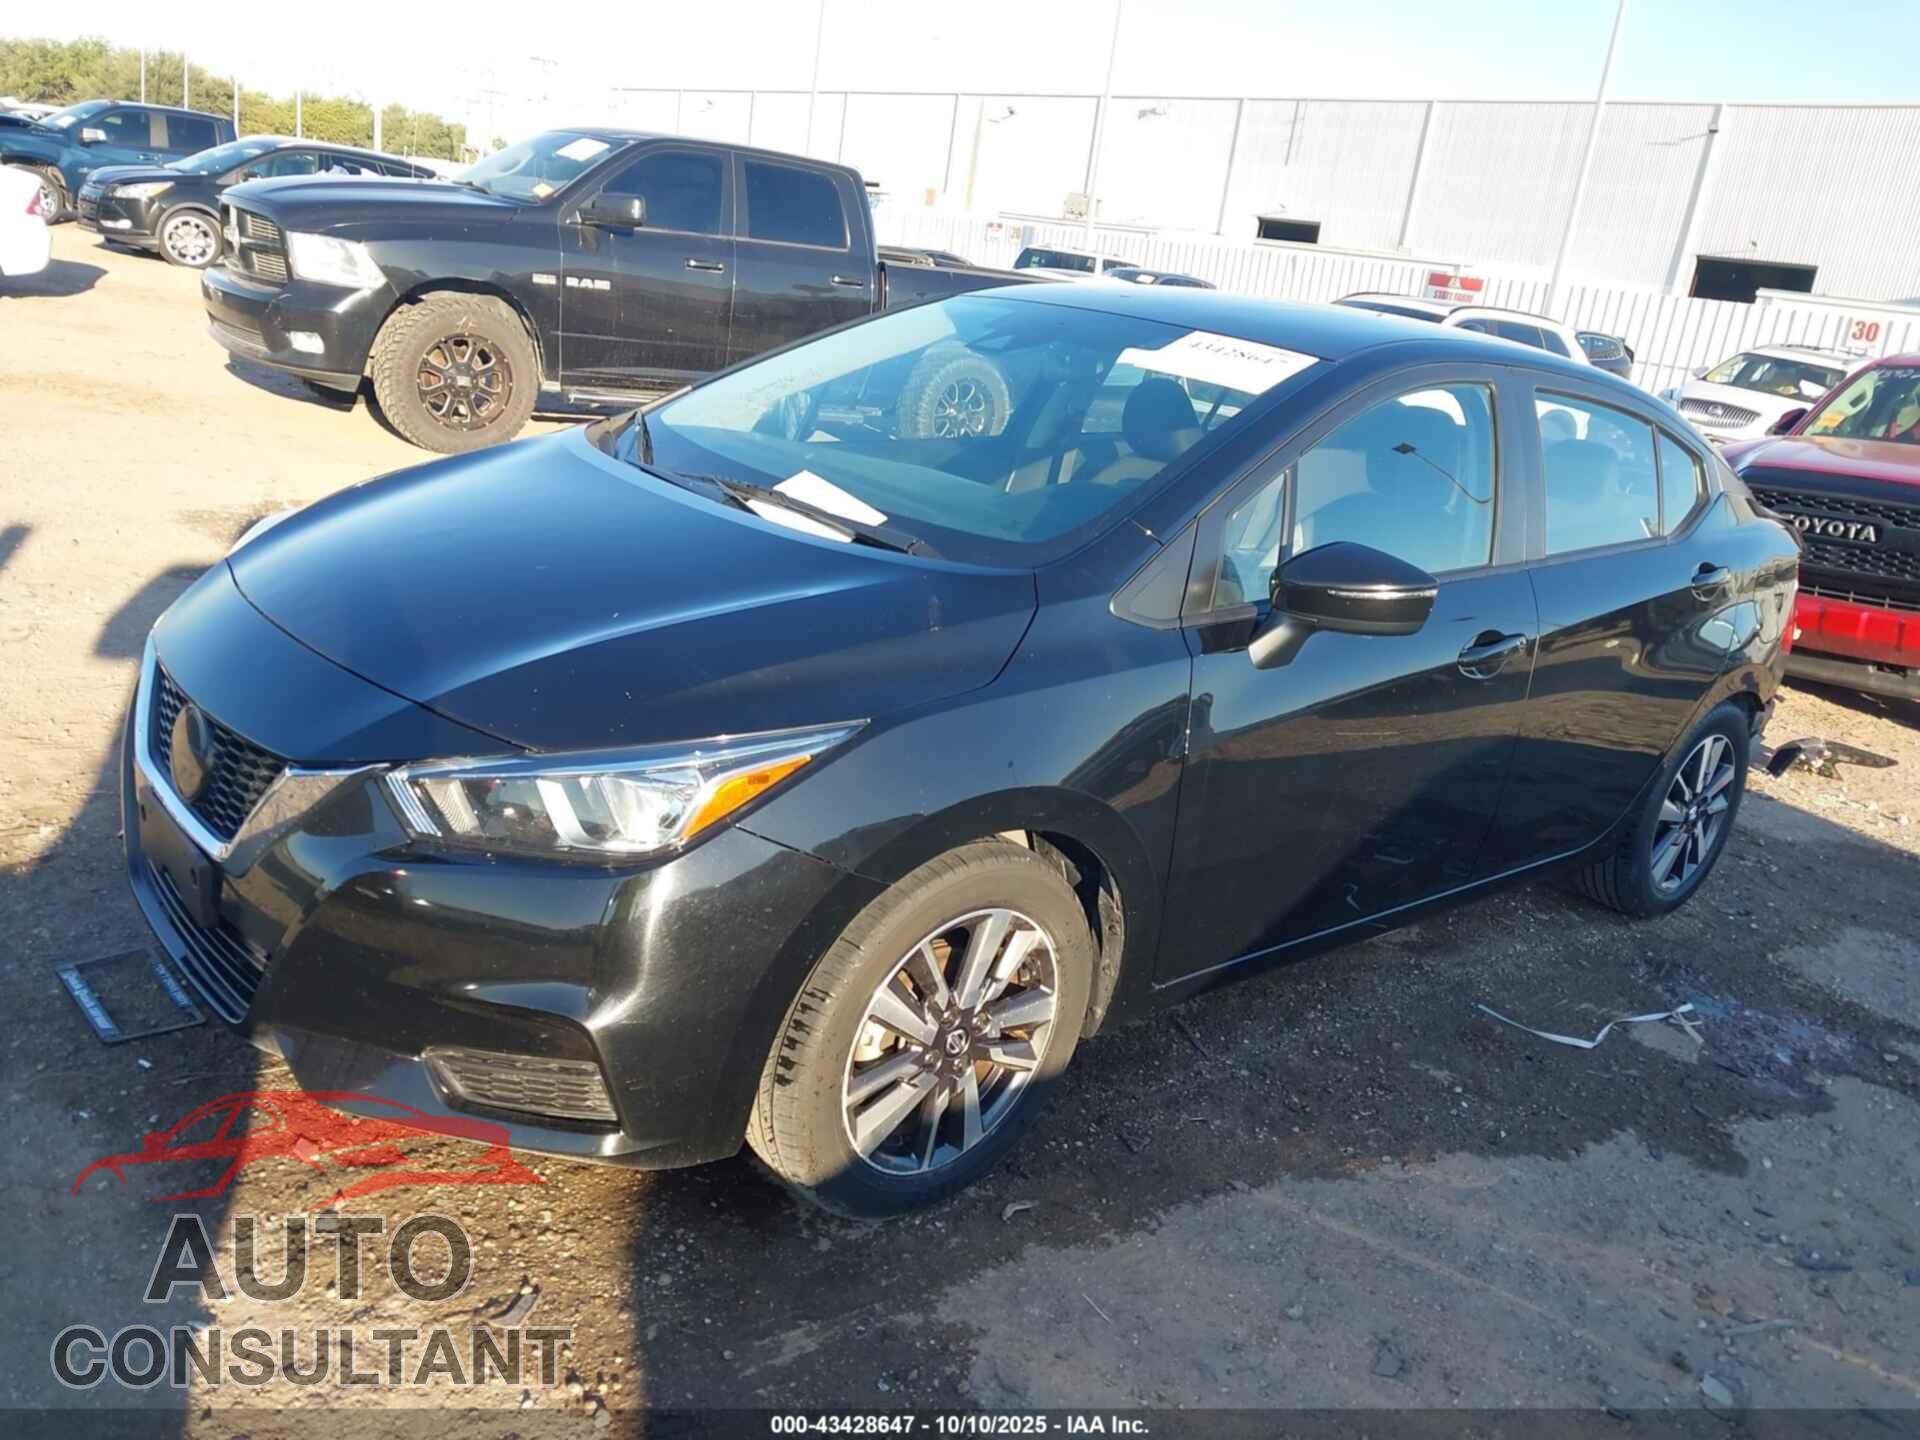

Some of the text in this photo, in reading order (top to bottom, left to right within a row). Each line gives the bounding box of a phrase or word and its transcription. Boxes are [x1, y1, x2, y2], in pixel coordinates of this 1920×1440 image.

[566, 276, 611, 290] RAM
[1852, 320, 1880, 342] 30
[1790, 514, 1877, 542] OYOTA
